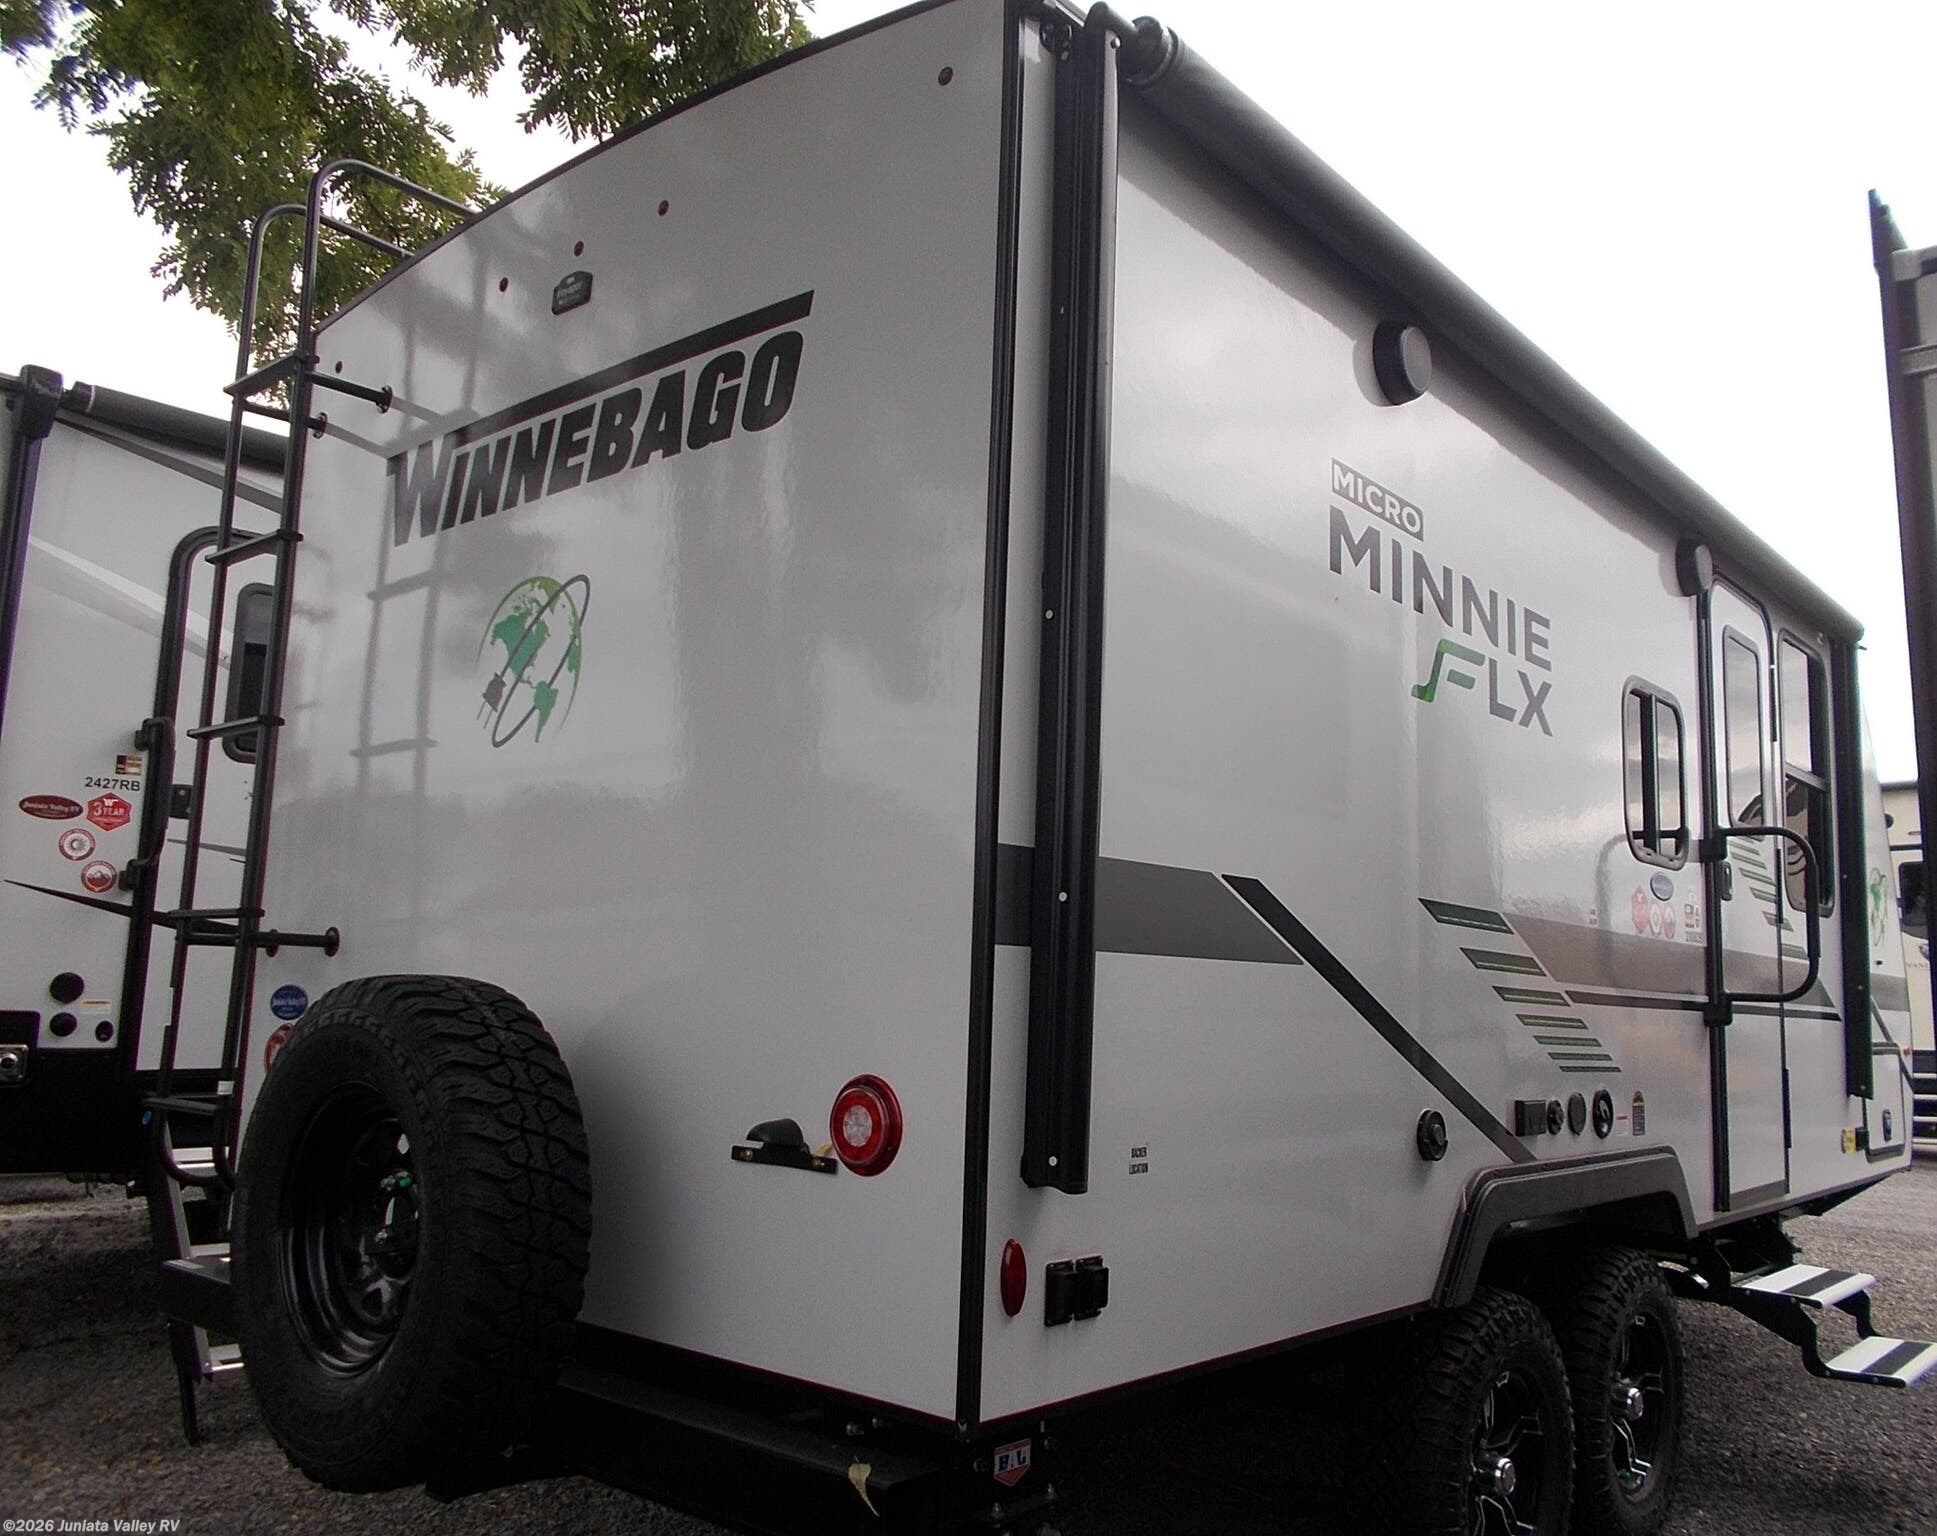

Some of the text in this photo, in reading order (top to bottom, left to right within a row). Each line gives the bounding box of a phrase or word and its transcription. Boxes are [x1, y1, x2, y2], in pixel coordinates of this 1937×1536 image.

[386, 331, 804, 548] WINNEBAGO
[1333, 464, 1422, 535] MICRO
[1329, 504, 1552, 673] MINNIE
[1410, 638, 1553, 737] FLX
[85, 776, 141, 791] 2427RB
[92, 801, 126, 816] 3 YEAR
